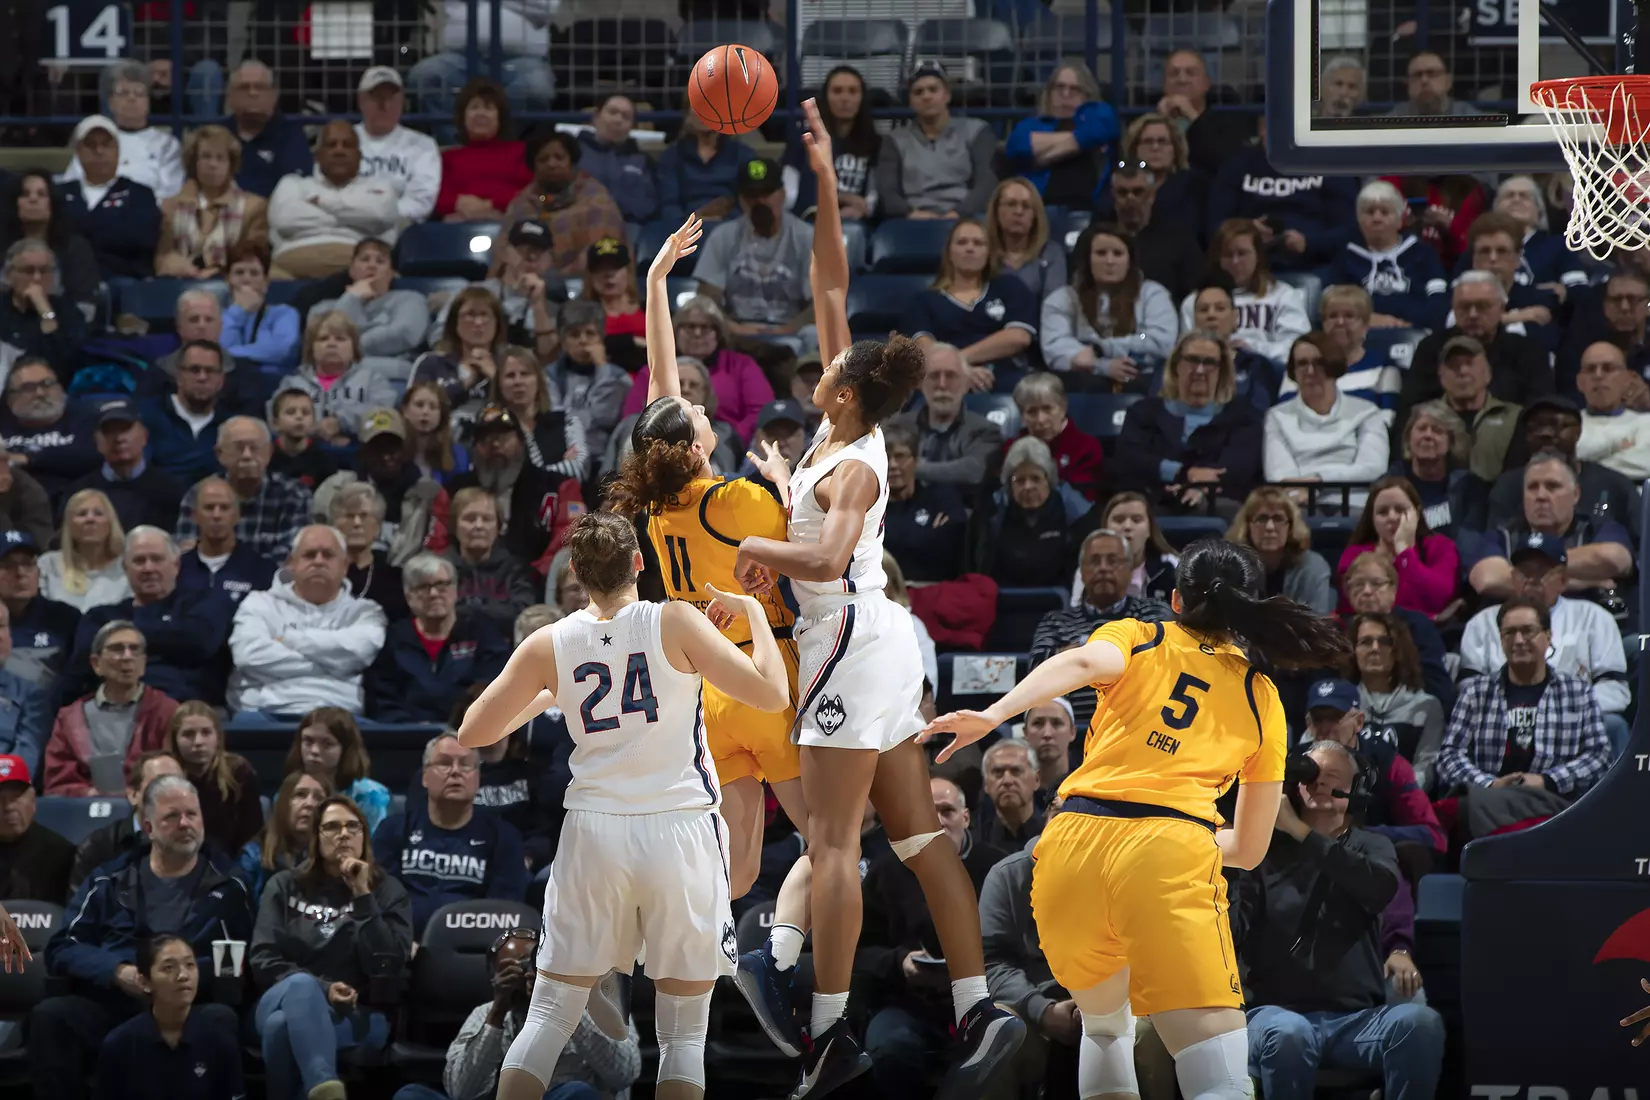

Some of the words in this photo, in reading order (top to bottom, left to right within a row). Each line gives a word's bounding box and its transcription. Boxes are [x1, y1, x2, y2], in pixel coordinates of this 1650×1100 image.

[46, 5, 127, 57] 14
[1242, 175, 1323, 197] UCONN
[664, 534, 697, 592] 11
[573, 652, 659, 734] 24
[1160, 672, 1211, 730] 5
[1146, 730, 1181, 756] CHEN
[402, 849, 487, 879] UCONN
[446, 913, 521, 929] UCONN
